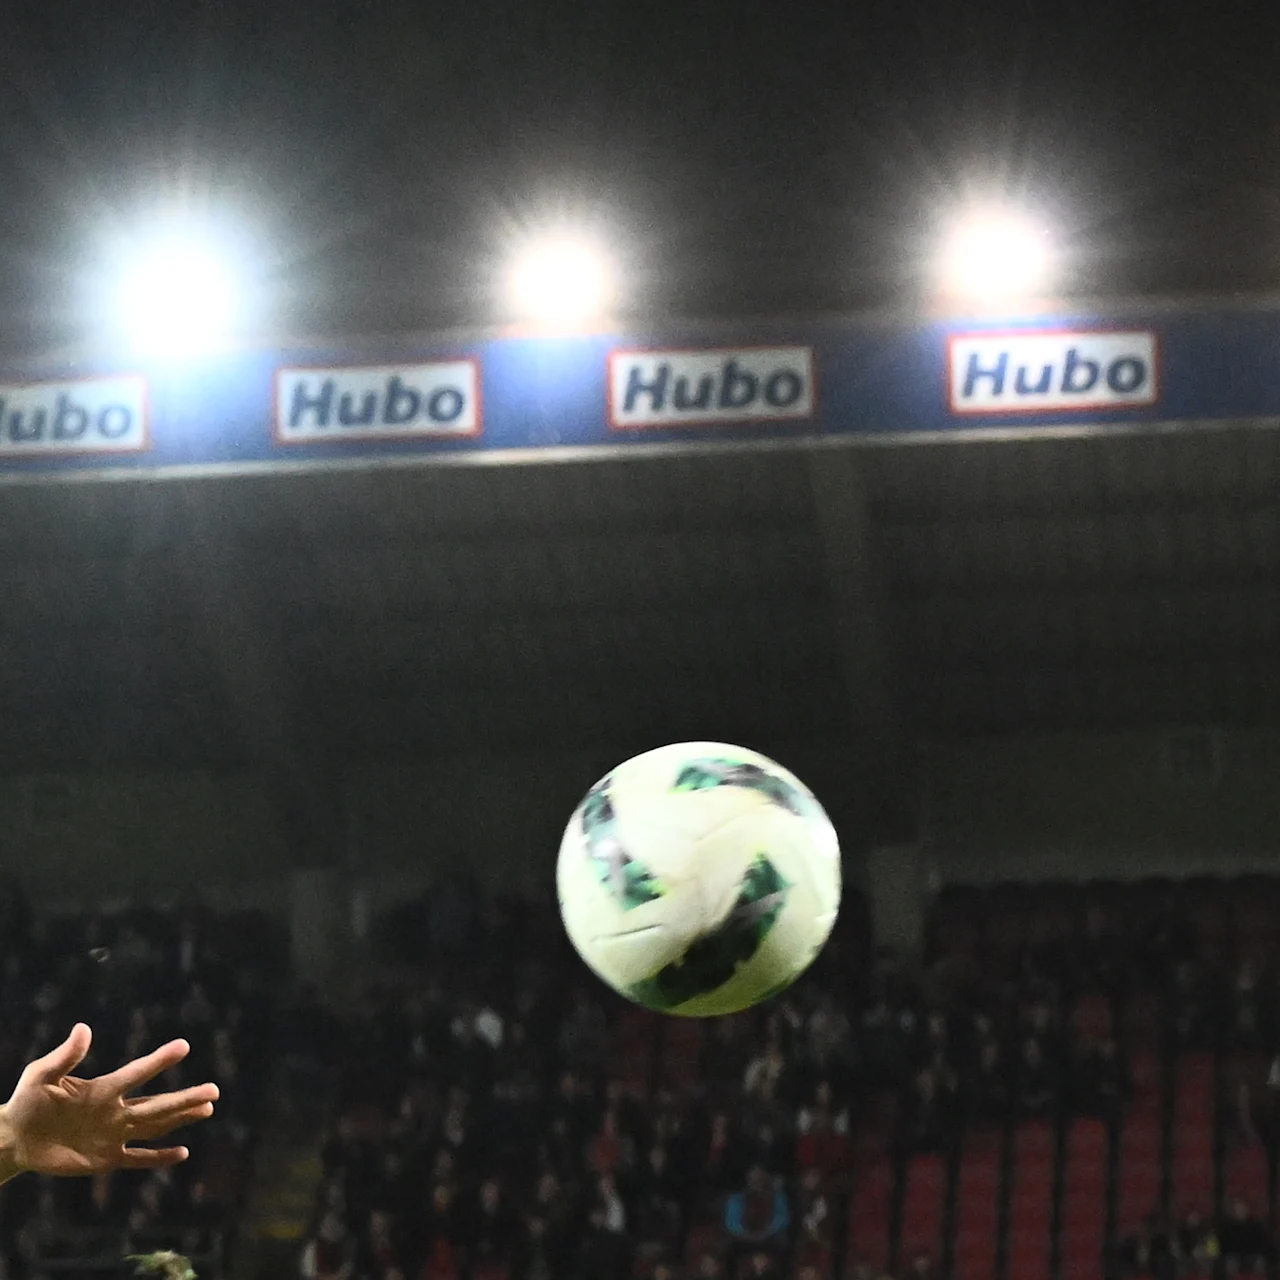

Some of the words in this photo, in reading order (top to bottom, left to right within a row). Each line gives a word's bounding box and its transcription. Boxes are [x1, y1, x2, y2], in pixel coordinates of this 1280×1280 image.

[622, 356, 803, 413] Hubo
[962, 341, 1146, 399] Hubo
[287, 370, 464, 429] Hubo
